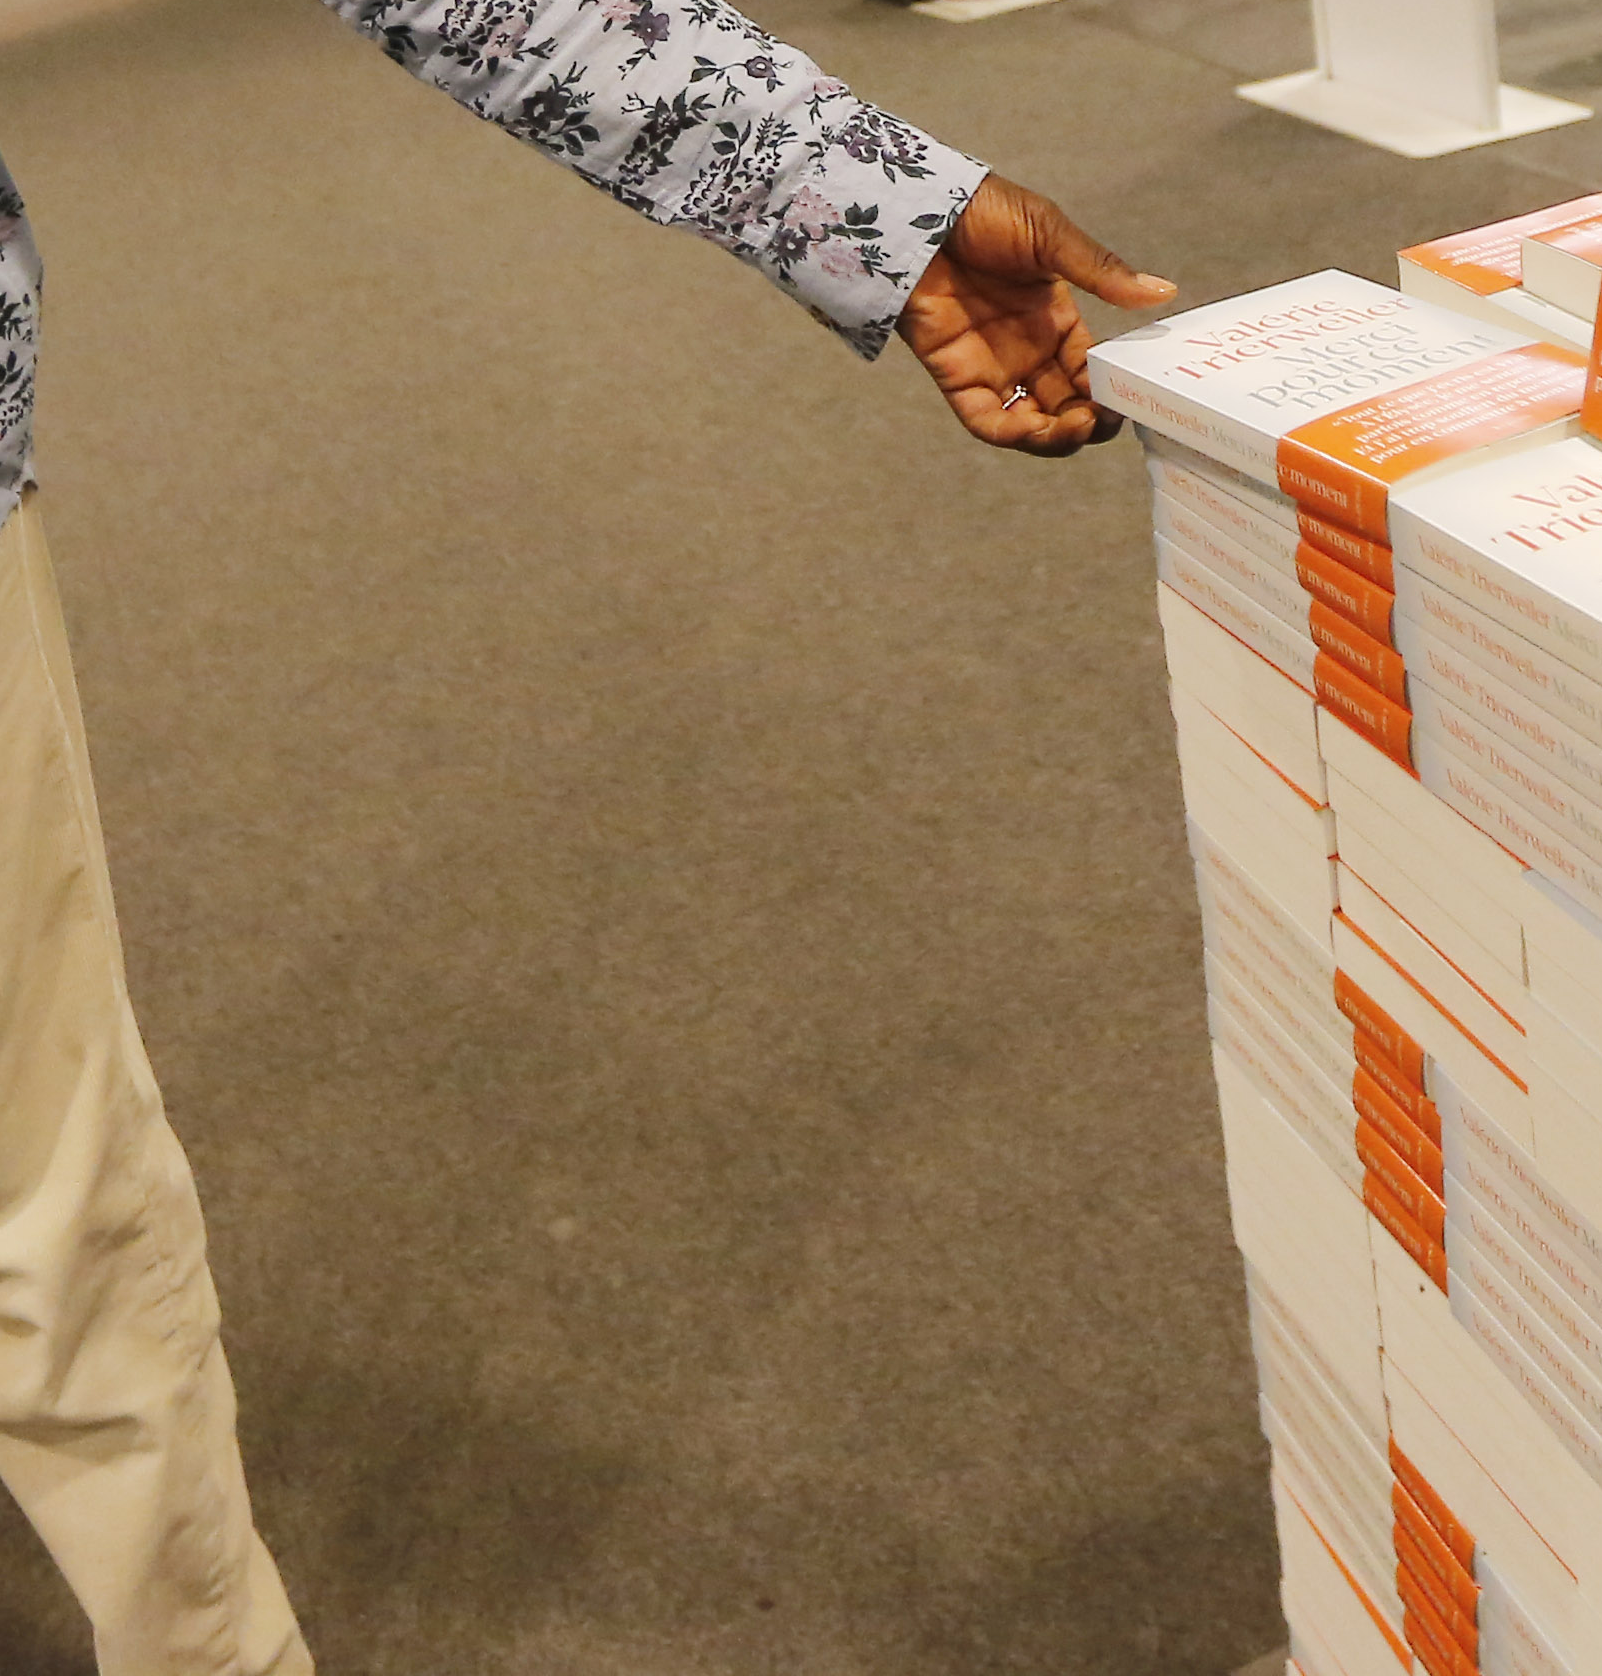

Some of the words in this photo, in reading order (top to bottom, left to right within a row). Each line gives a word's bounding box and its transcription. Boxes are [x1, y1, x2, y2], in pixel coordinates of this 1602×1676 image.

[1164, 295, 1414, 380] Trierweiler
[1184, 298, 1338, 349] Valérie
[1273, 320, 1419, 369] Merci
[1247, 353, 1366, 410] pour
[1367, 338, 1425, 362] ce
[1289, 333, 1499, 410] moment
